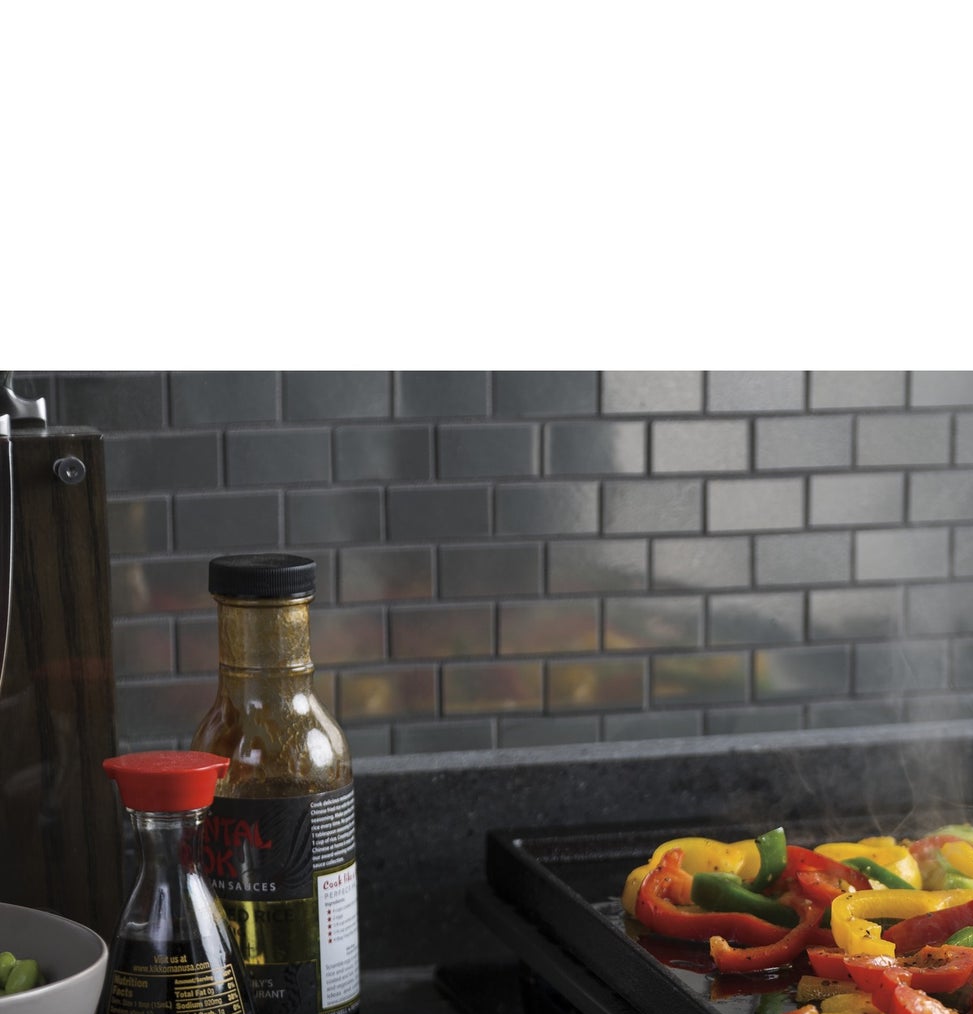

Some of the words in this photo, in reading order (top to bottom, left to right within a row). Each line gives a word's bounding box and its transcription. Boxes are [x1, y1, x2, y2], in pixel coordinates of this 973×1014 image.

[228, 881, 277, 892] SAUCES
[323, 875, 342, 890] Cook
[255, 910, 295, 922] RICE
[170, 955, 179, 964] us
[180, 954, 188, 962] at
[133, 961, 210, 973] www.kikkomanusa.com
[113, 975, 149, 988] Nutrition
[112, 985, 134, 998] Facts
[175, 990, 194, 999] Total
[195, 988, 207, 997] Fat
[175, 1001, 203, 1010] Sodium
